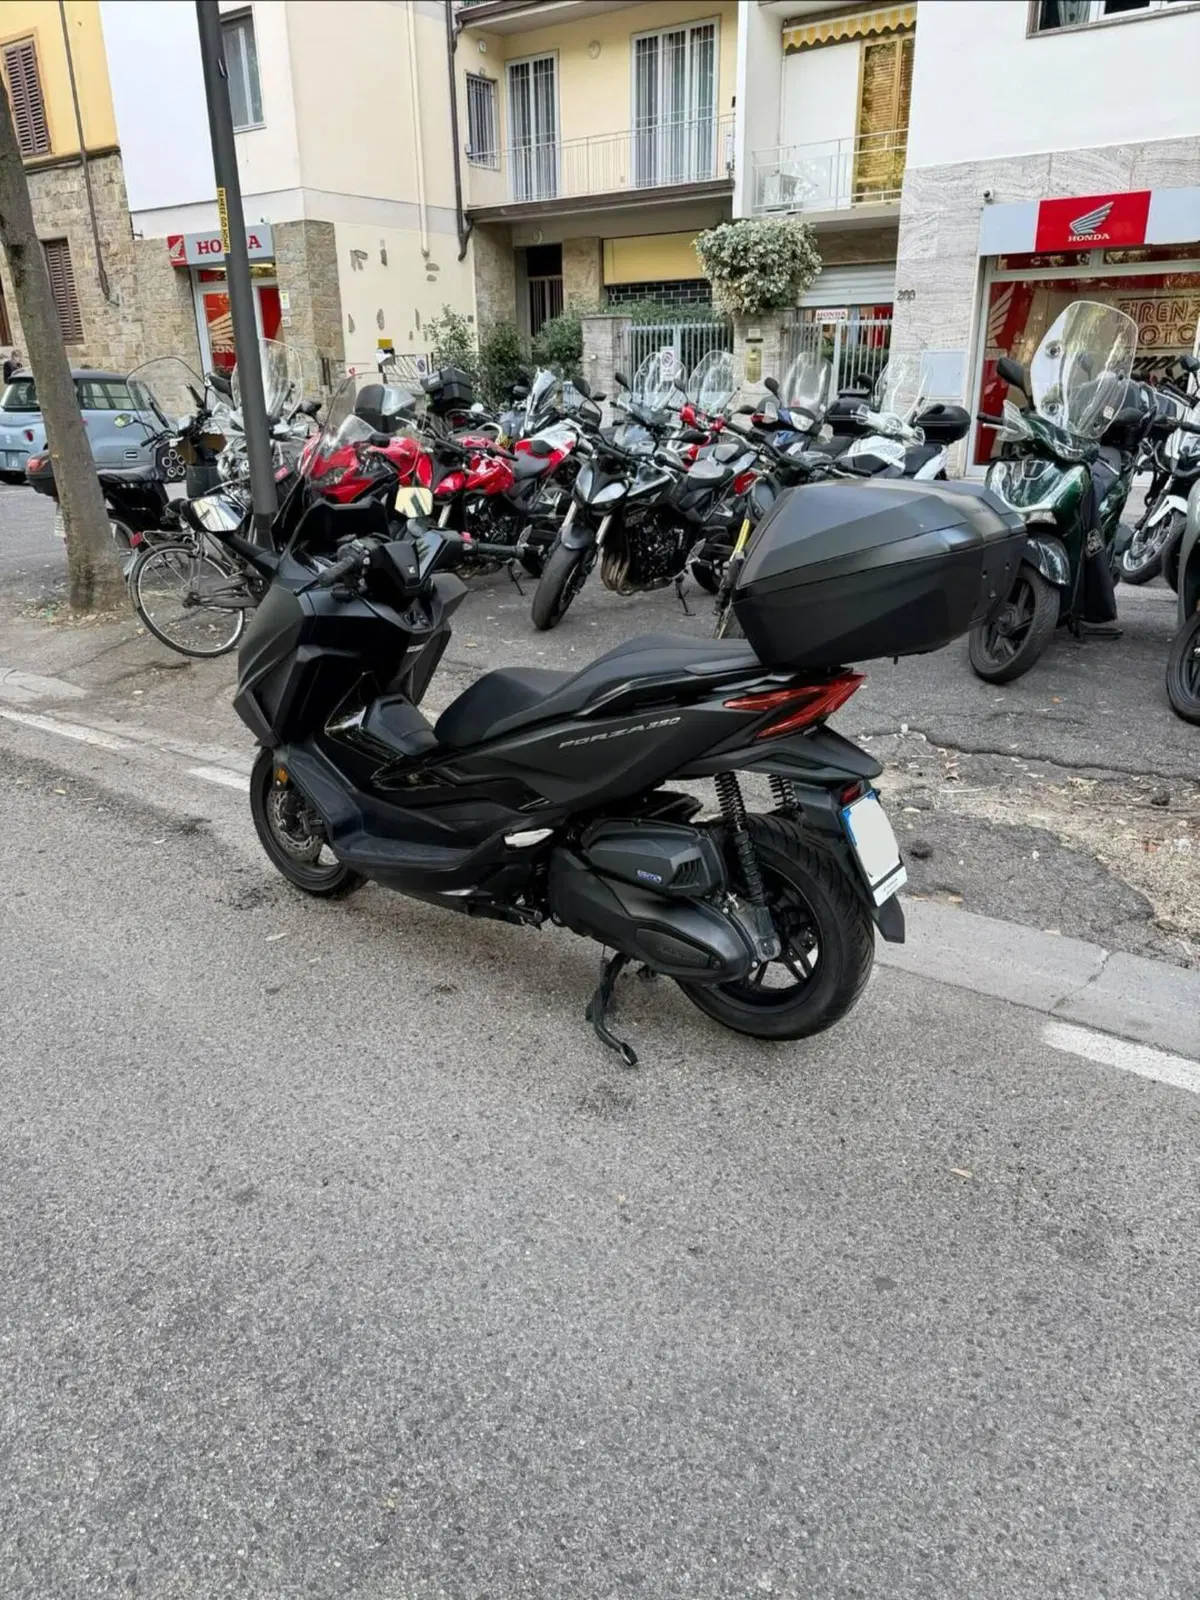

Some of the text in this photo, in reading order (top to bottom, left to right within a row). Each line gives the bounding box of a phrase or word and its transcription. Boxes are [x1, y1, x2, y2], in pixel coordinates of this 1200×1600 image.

[221, 216, 228, 227] GO
[1067, 232, 1110, 242] HONDA
[196, 235, 262, 255] HOA
[1127, 323, 1197, 346] OTO
